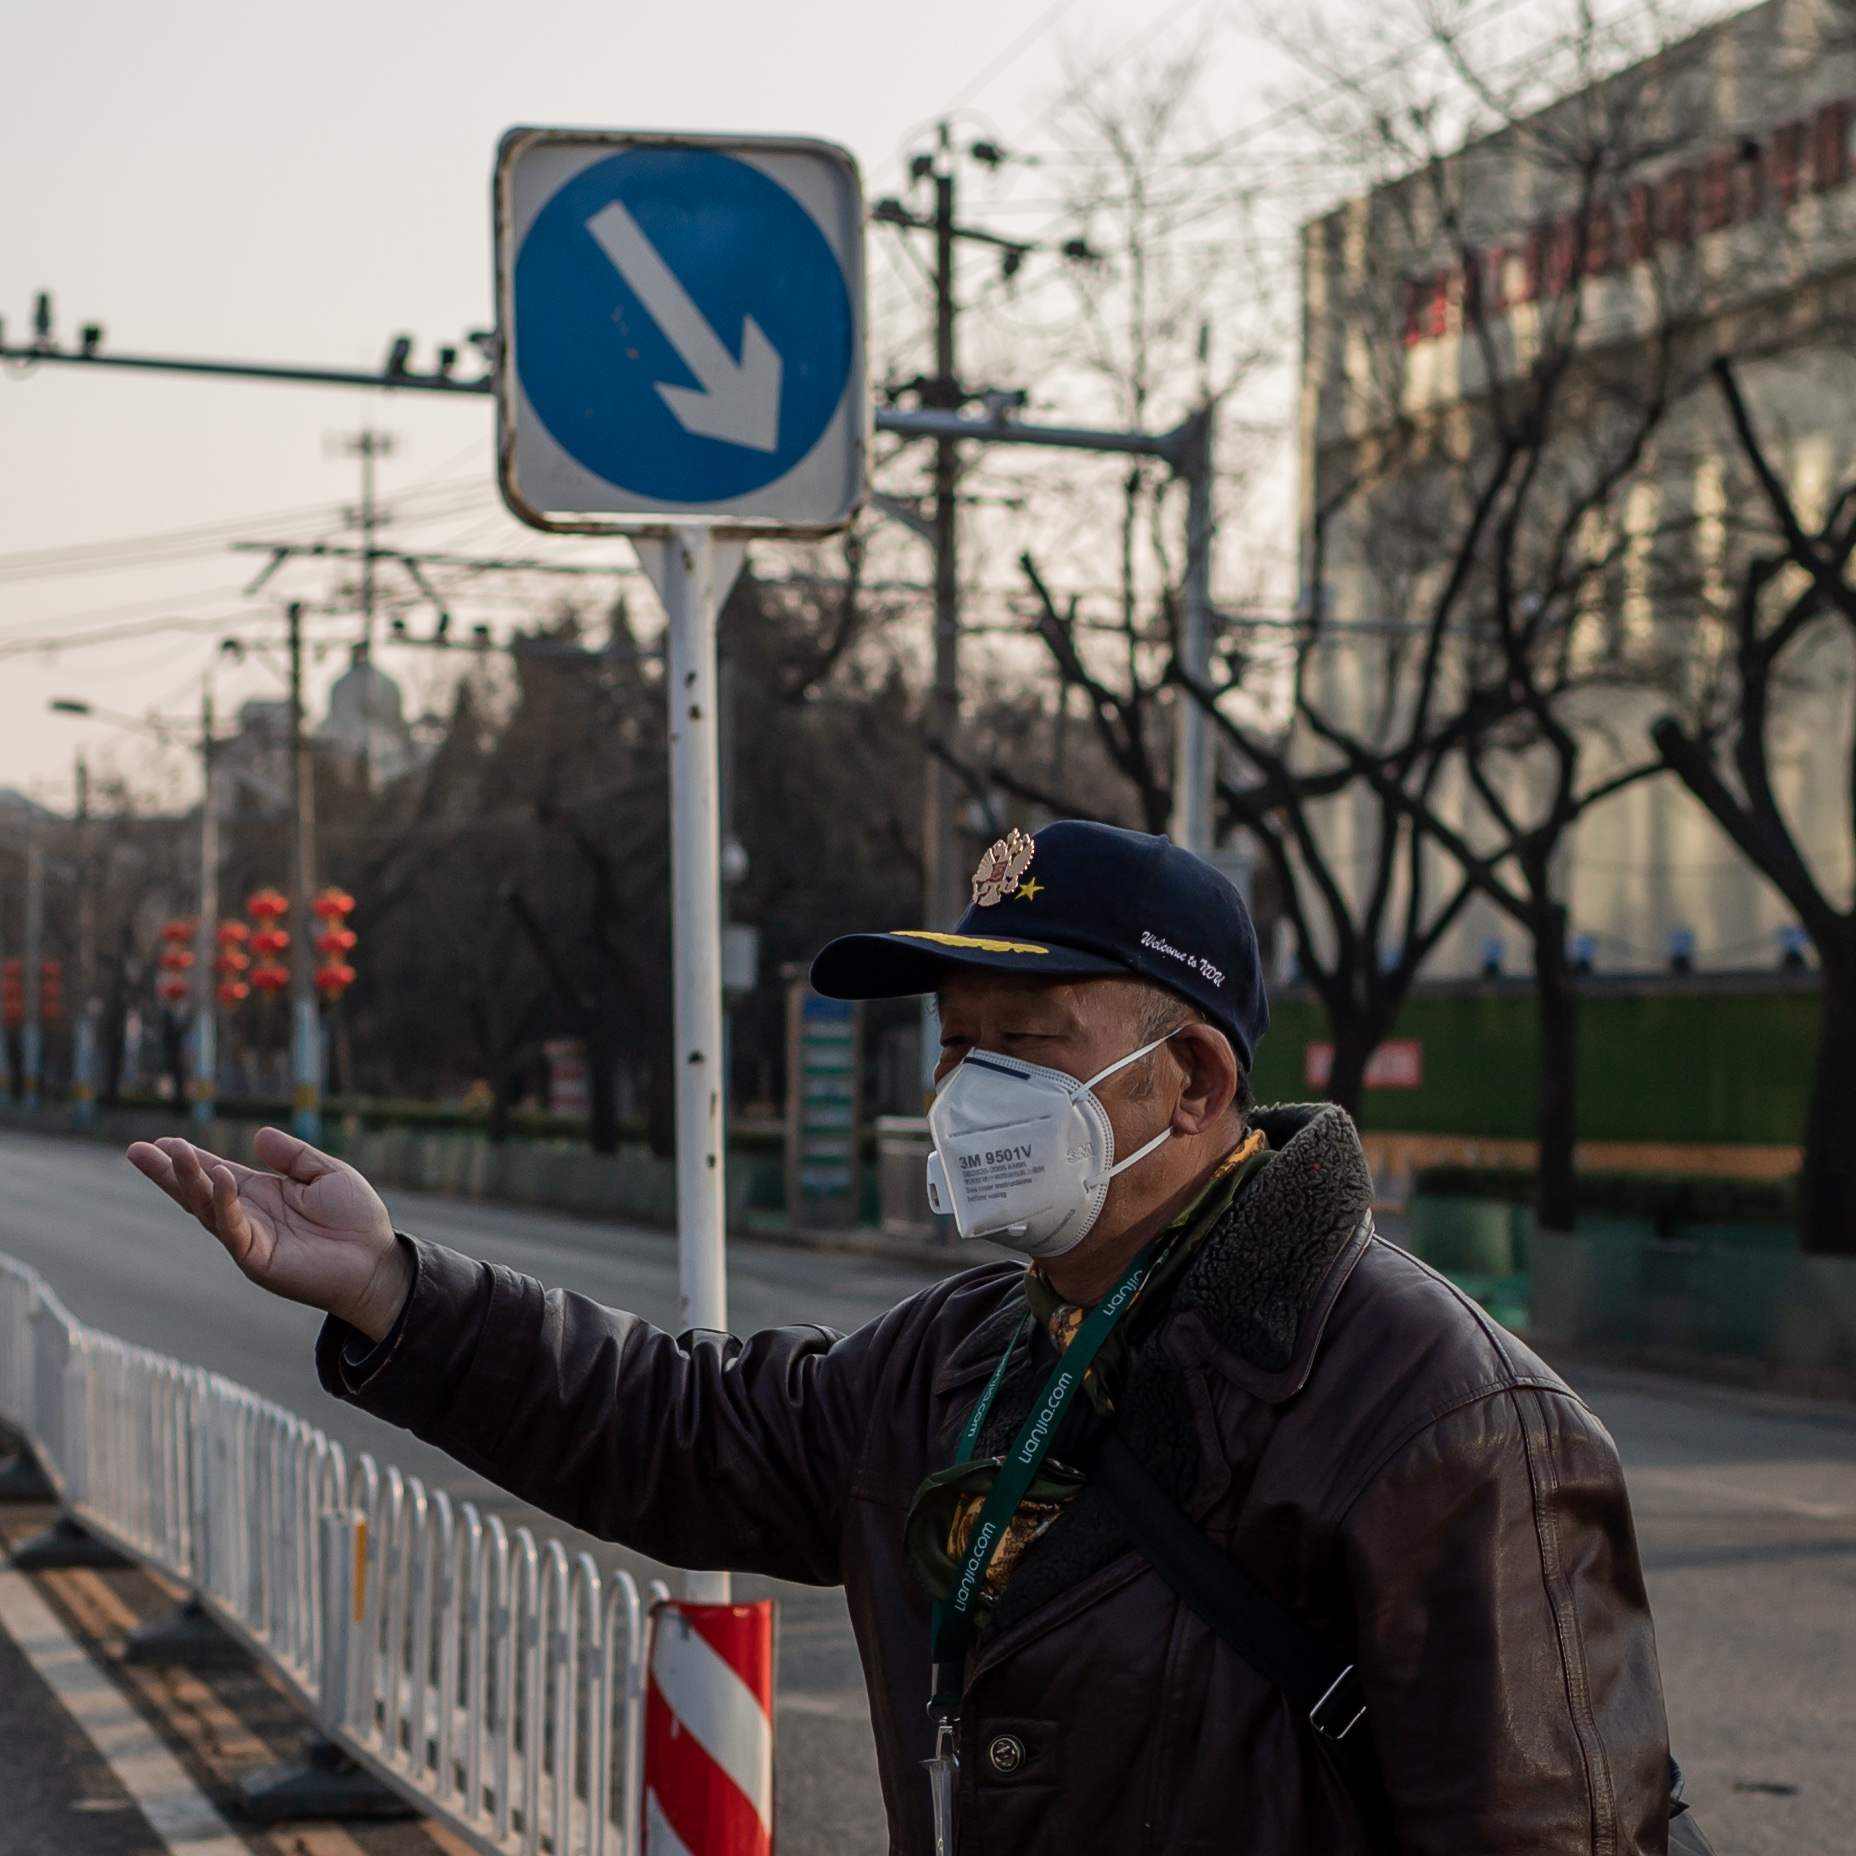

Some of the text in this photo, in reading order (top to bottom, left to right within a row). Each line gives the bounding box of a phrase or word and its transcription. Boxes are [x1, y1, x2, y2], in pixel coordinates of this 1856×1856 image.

[1140, 930, 1188, 963] Welcome
[1187, 954, 1198, 968] to
[958, 1153, 982, 1170] 3M
[985, 1144, 1033, 1166] 9501V
